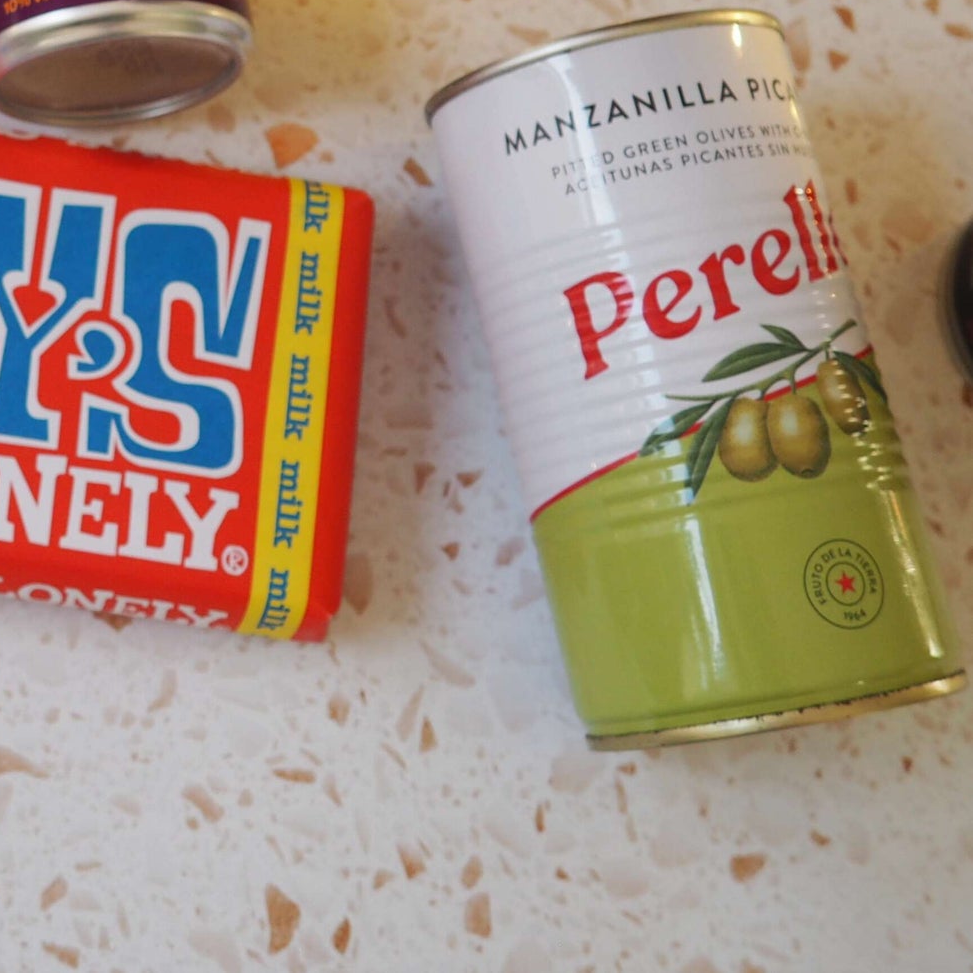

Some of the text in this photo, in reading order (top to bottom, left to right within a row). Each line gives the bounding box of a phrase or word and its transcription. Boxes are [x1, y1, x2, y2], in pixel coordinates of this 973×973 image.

[504, 79, 738, 156] MANZANILLA
[622, 134, 689, 160] GREEN
[696, 125, 755, 145] OLIVES
[680, 144, 765, 168] PICANTES
[293, 251, 322, 336] milk
[283, 352, 314, 442] milk
[273, 459, 302, 548] milk
[820, 548, 836, 564] DE
[838, 546, 853, 558] LA
